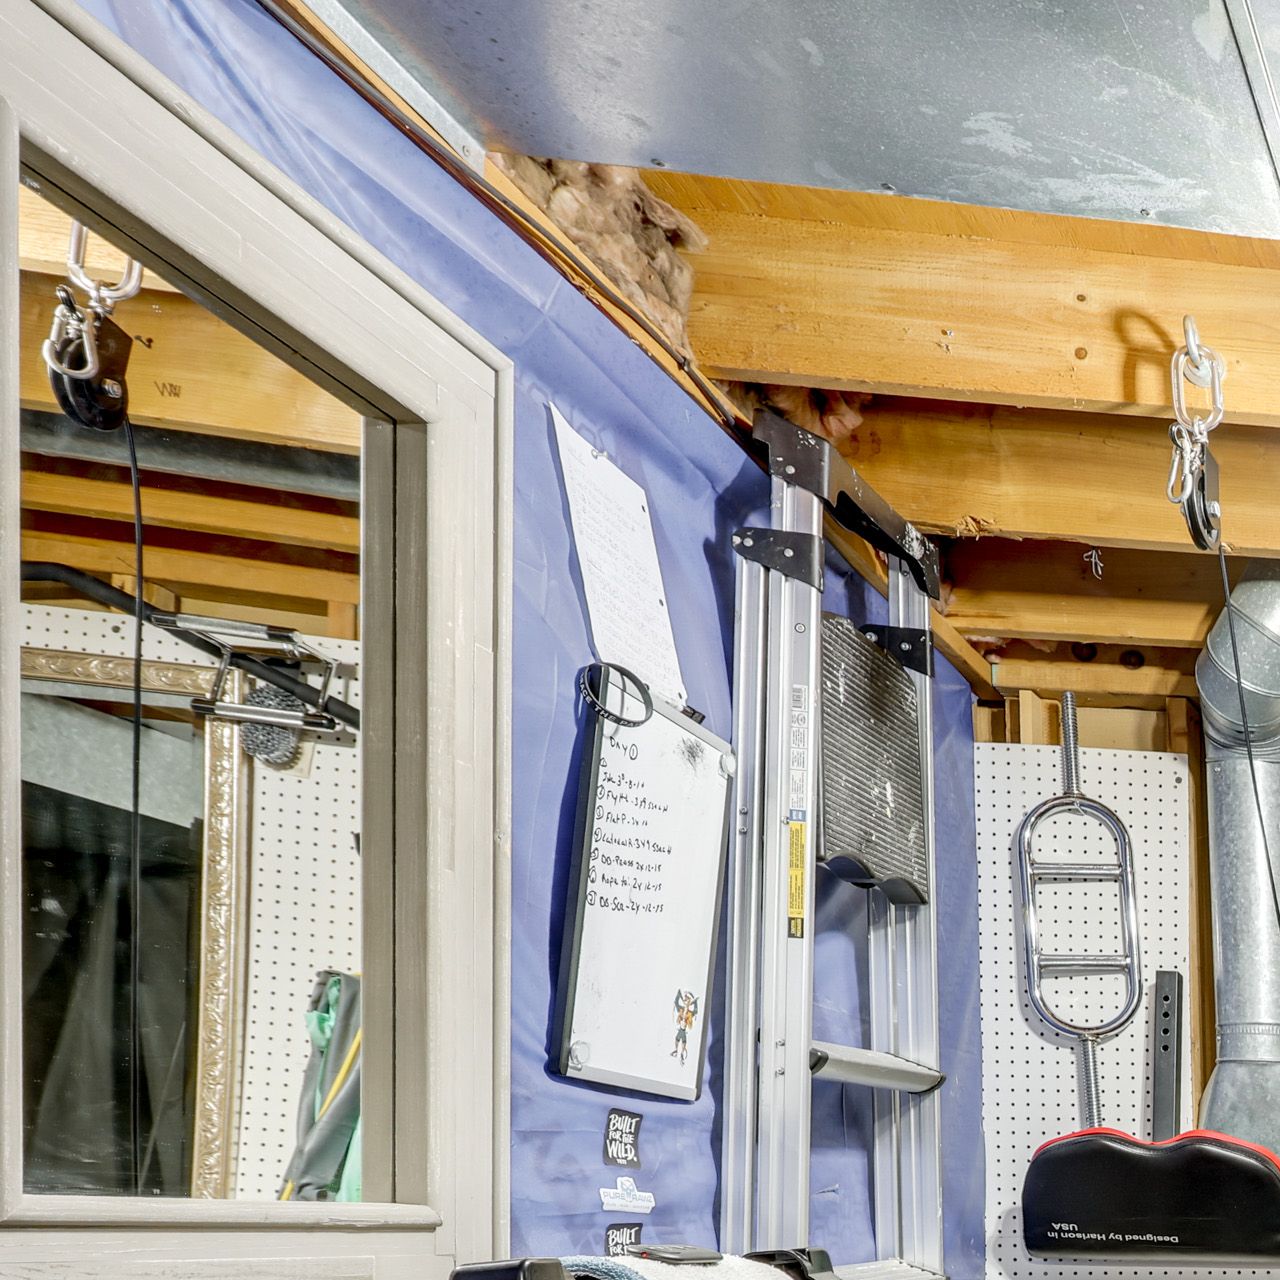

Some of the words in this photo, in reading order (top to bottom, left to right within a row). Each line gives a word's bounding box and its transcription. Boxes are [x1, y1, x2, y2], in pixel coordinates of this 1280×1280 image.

[594, 705, 617, 723] THE
[608, 1113, 641, 1134] BUILT
[608, 1130, 622, 1141] FOR
[1051, 1222, 1079, 1232] USA
[607, 1226, 640, 1246] BUILT
[1047, 1230, 1058, 1239] in
[1060, 1231, 1106, 1241] Harison
[1108, 1232, 1122, 1242] by
[1125, 1233, 1179, 1243] Designed
